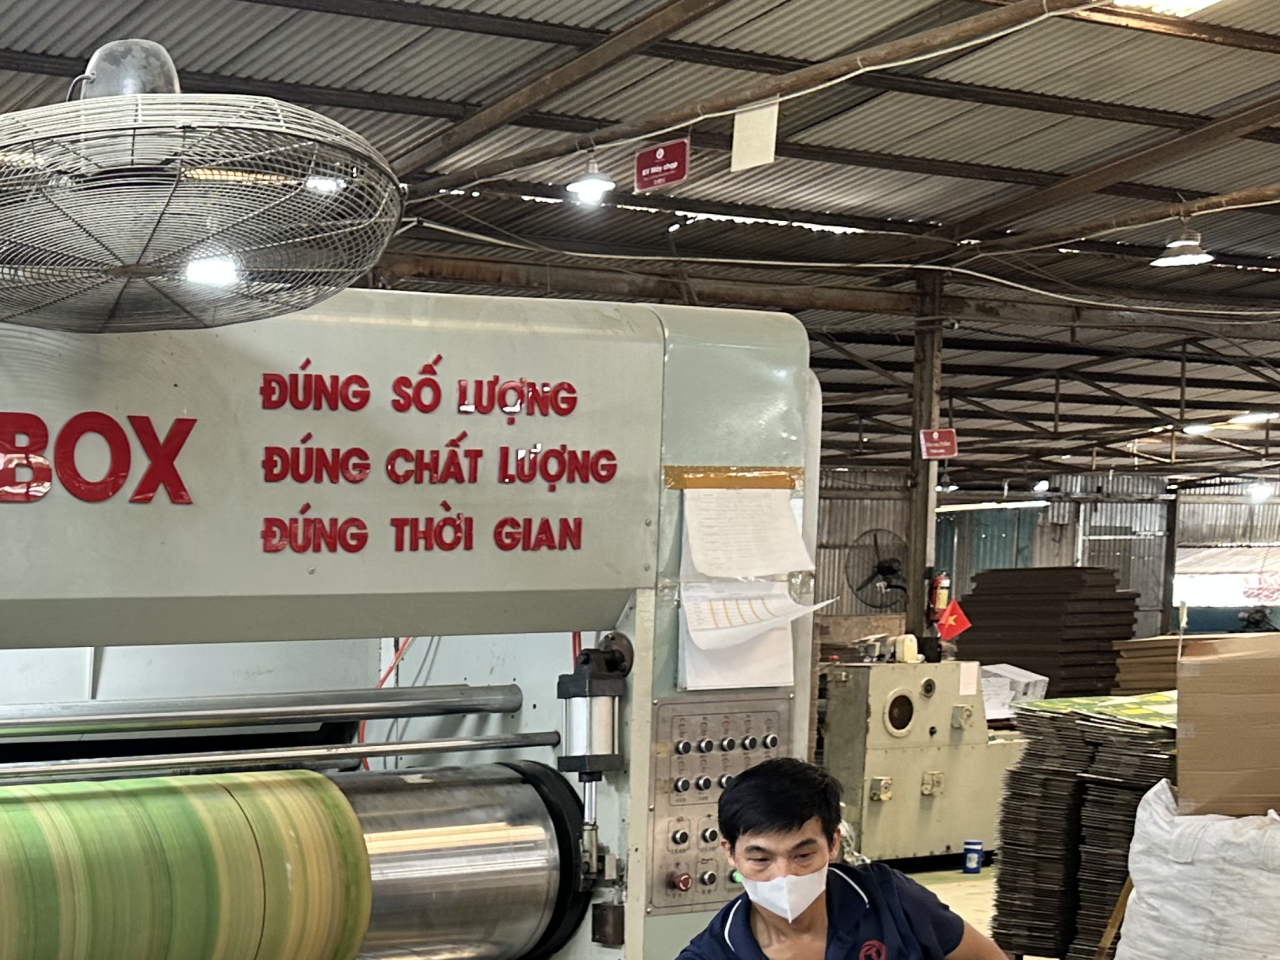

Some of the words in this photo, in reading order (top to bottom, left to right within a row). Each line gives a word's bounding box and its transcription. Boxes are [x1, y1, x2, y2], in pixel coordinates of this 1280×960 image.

[260, 358, 370, 412] ĐÚNG
[391, 354, 443, 414] SỐ
[457, 375, 578, 425] LƯỢNG
[262, 432, 371, 484] ĐÚNG
[386, 431, 483, 484] CHẤT
[498, 443, 618, 492] LƯỢNG
[260, 503, 369, 553] ĐÚNG
[389, 500, 474, 552] THỜI
[493, 516, 583, 551] GIAN
